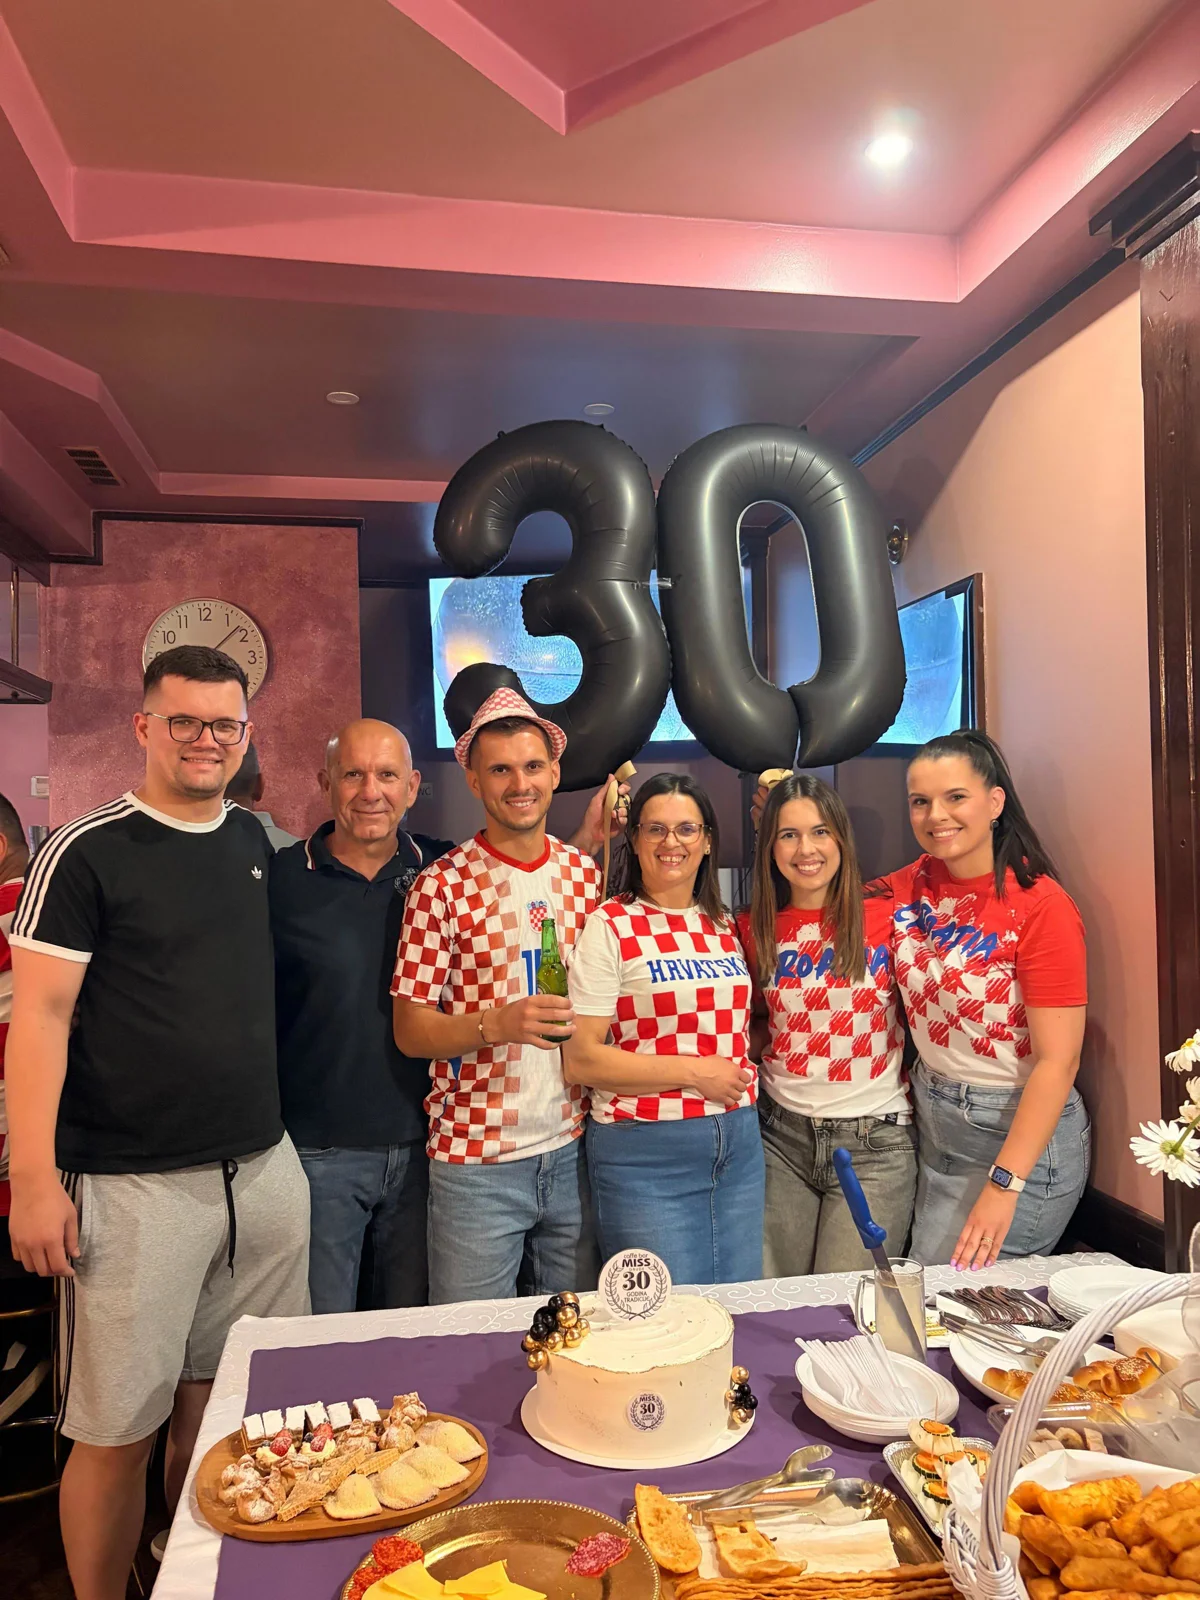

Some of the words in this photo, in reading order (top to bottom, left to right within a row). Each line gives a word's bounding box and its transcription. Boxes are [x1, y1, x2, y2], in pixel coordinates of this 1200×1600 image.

[433, 419, 907, 792] 30
[198, 607, 212, 621] 12
[225, 613, 230, 627] 1
[177, 615, 188, 628] 11
[162, 630, 176, 644] 10
[239, 628, 249, 643] 2
[247, 650, 257, 665] 3
[622, 1258, 650, 1267] MISS
[622, 1270, 651, 1291] 30
[640, 1403, 655, 1414] 30
